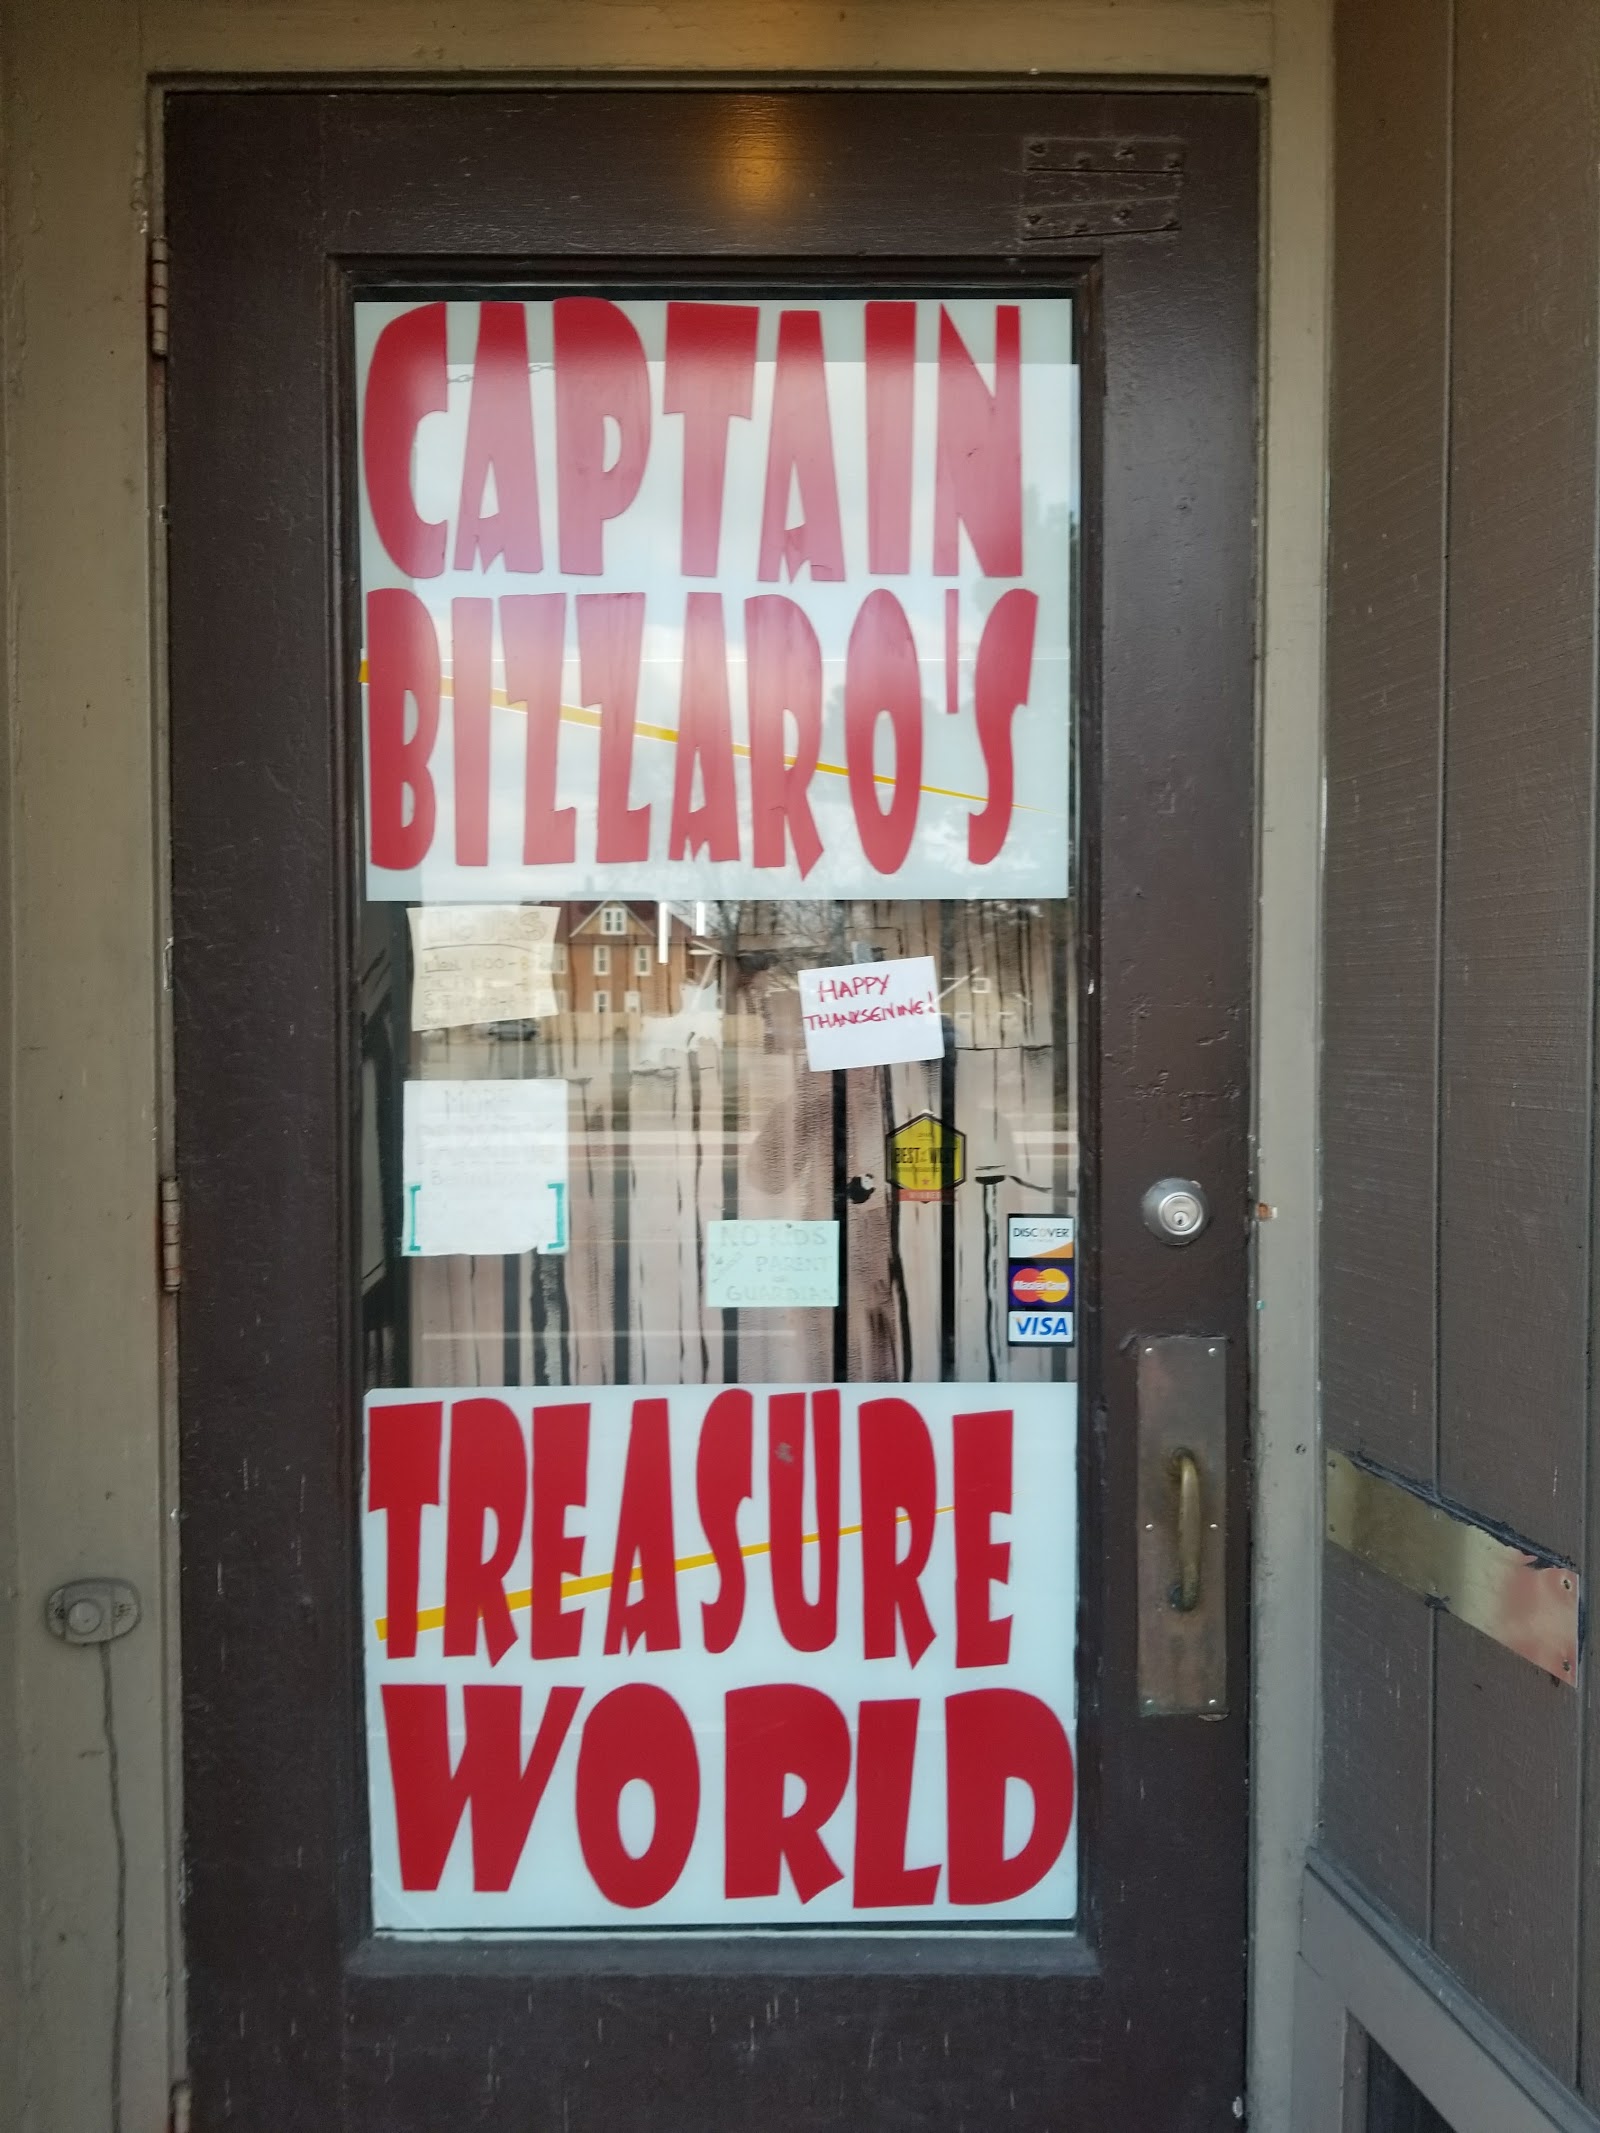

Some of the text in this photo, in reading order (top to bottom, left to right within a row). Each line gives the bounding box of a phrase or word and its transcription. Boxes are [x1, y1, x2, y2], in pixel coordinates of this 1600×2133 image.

[363, 297, 1023, 583] CAPTAIN
[367, 588, 1039, 880] BIZZARO'S
[818, 974, 890, 1002] HAPPY
[1012, 1227, 1070, 1238] DISCOVER
[1014, 1316, 1068, 1336] VISA
[368, 1389, 1014, 1669] TREASURE
[381, 1683, 1075, 1910] WORLD
